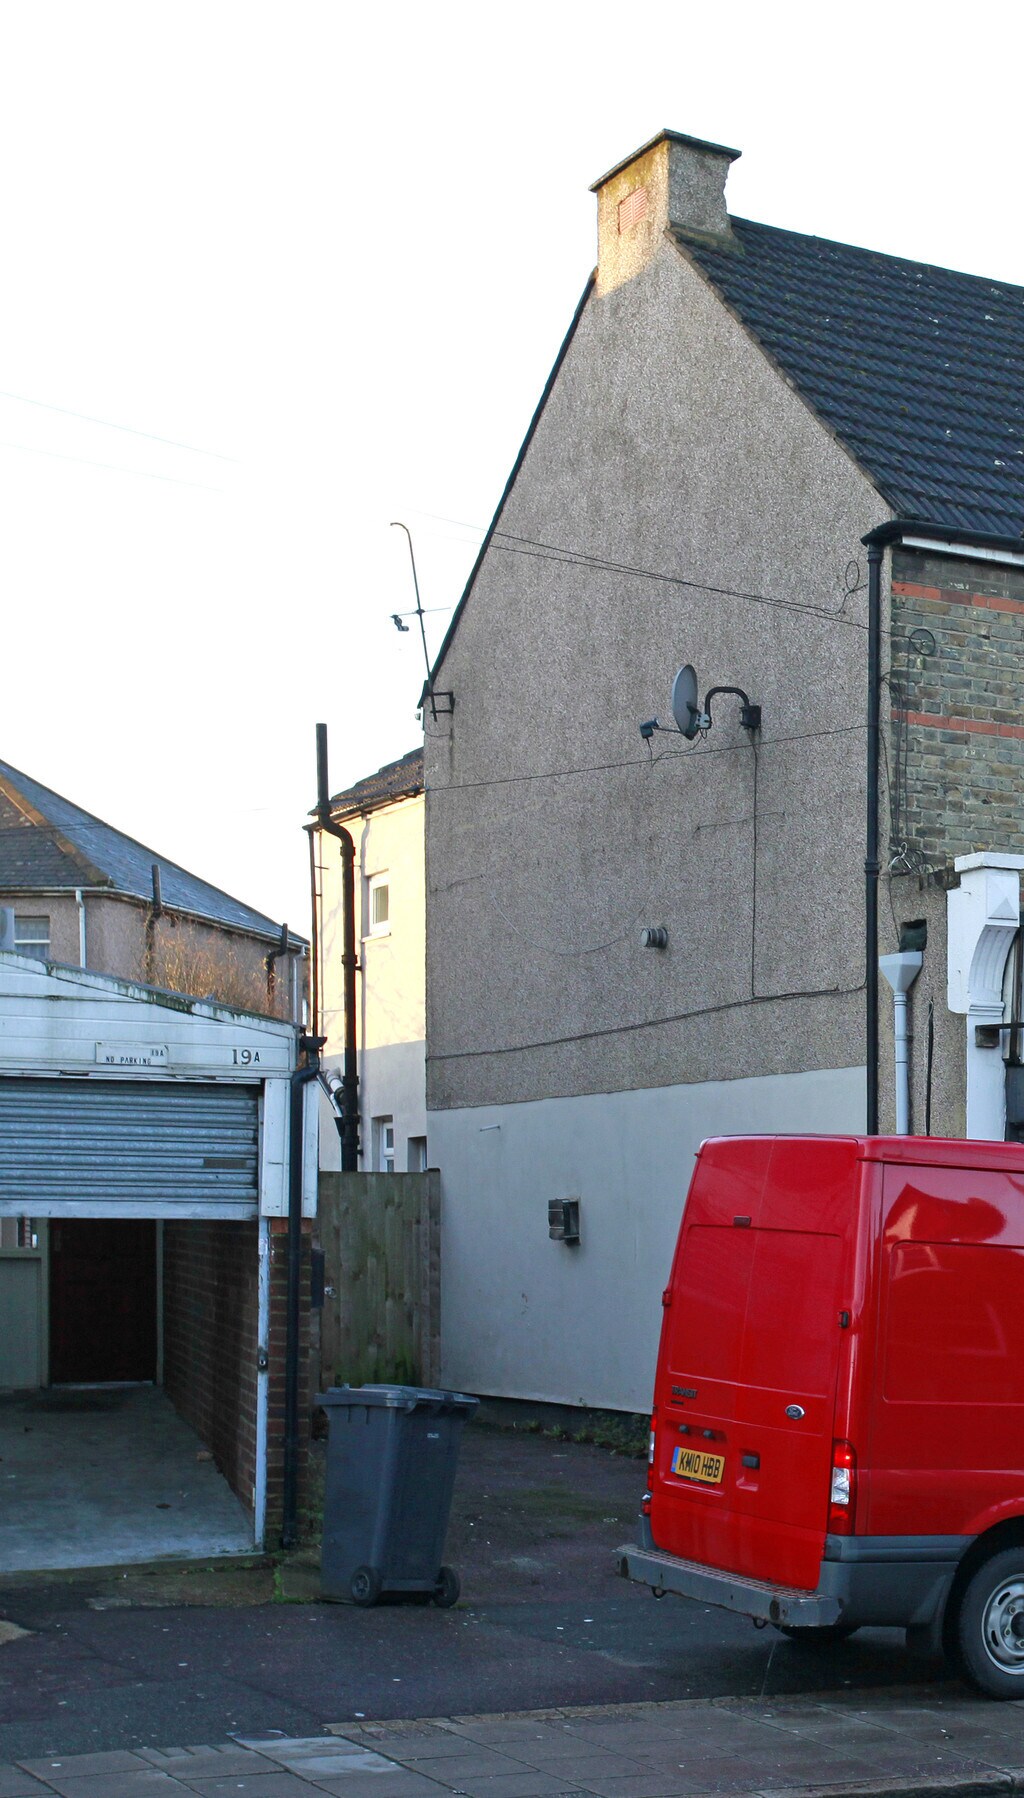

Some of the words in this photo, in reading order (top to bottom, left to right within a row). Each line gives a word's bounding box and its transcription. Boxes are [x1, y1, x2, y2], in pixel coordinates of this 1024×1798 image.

[120, 1057, 152, 1065] PARKING
[679, 1450, 701, 1475] KM10
[701, 1456, 721, 1479] HBB
